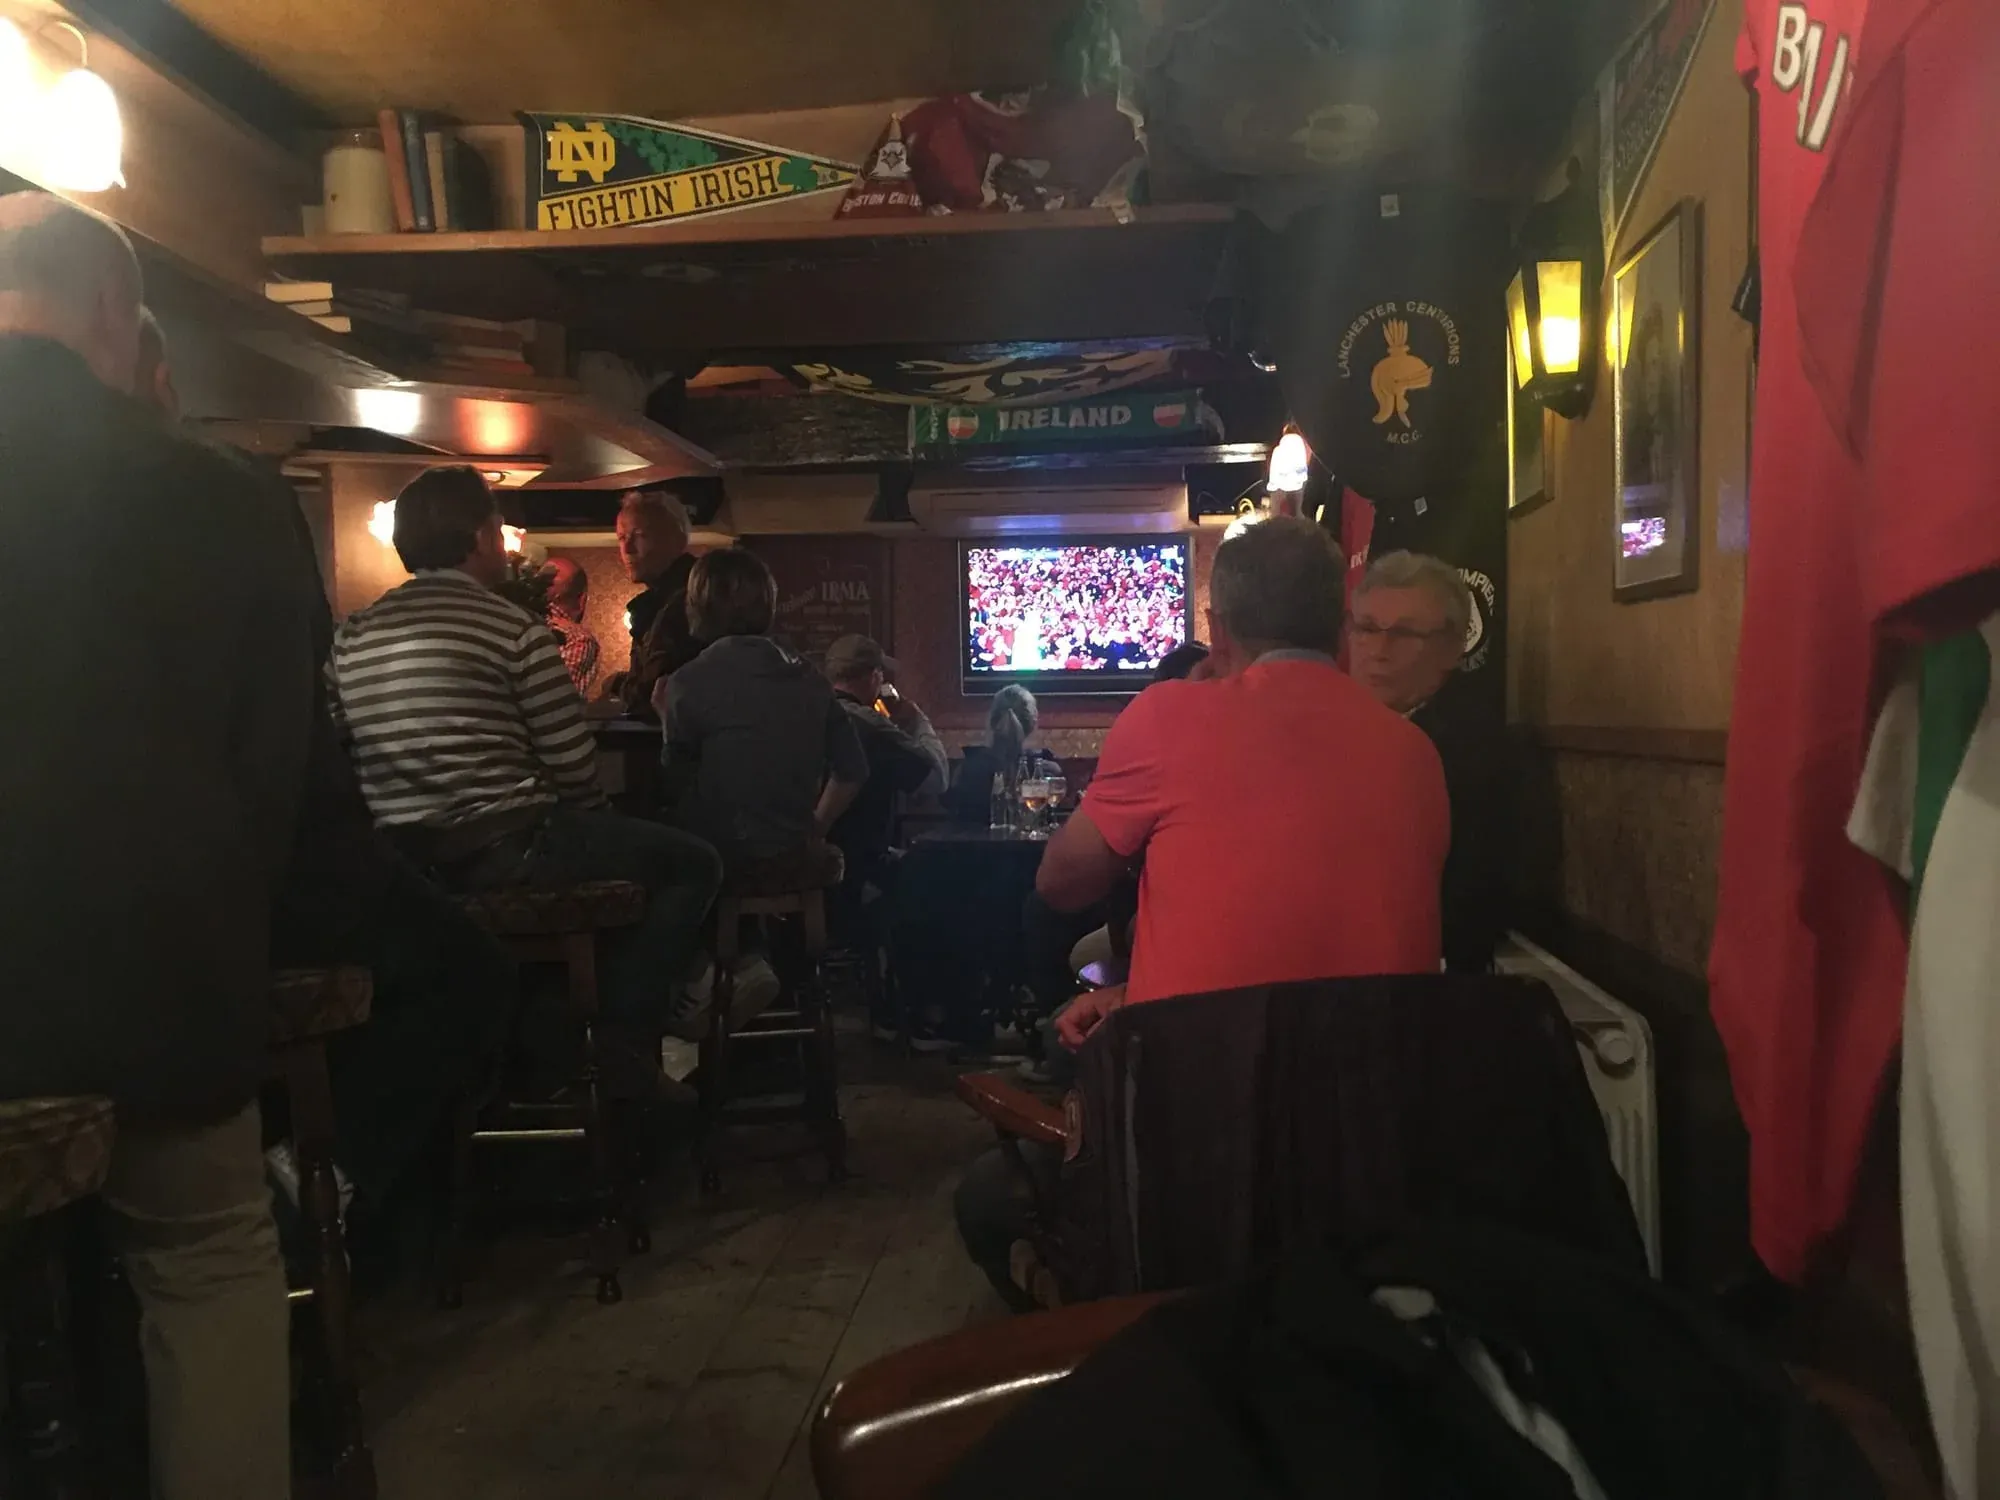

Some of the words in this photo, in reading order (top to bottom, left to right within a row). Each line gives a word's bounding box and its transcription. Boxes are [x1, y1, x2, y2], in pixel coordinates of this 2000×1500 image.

[690, 159, 778, 208] IRISH
[1338, 302, 1397, 378] LANCHESTER
[1000, 405, 1131, 431] IRELAND
